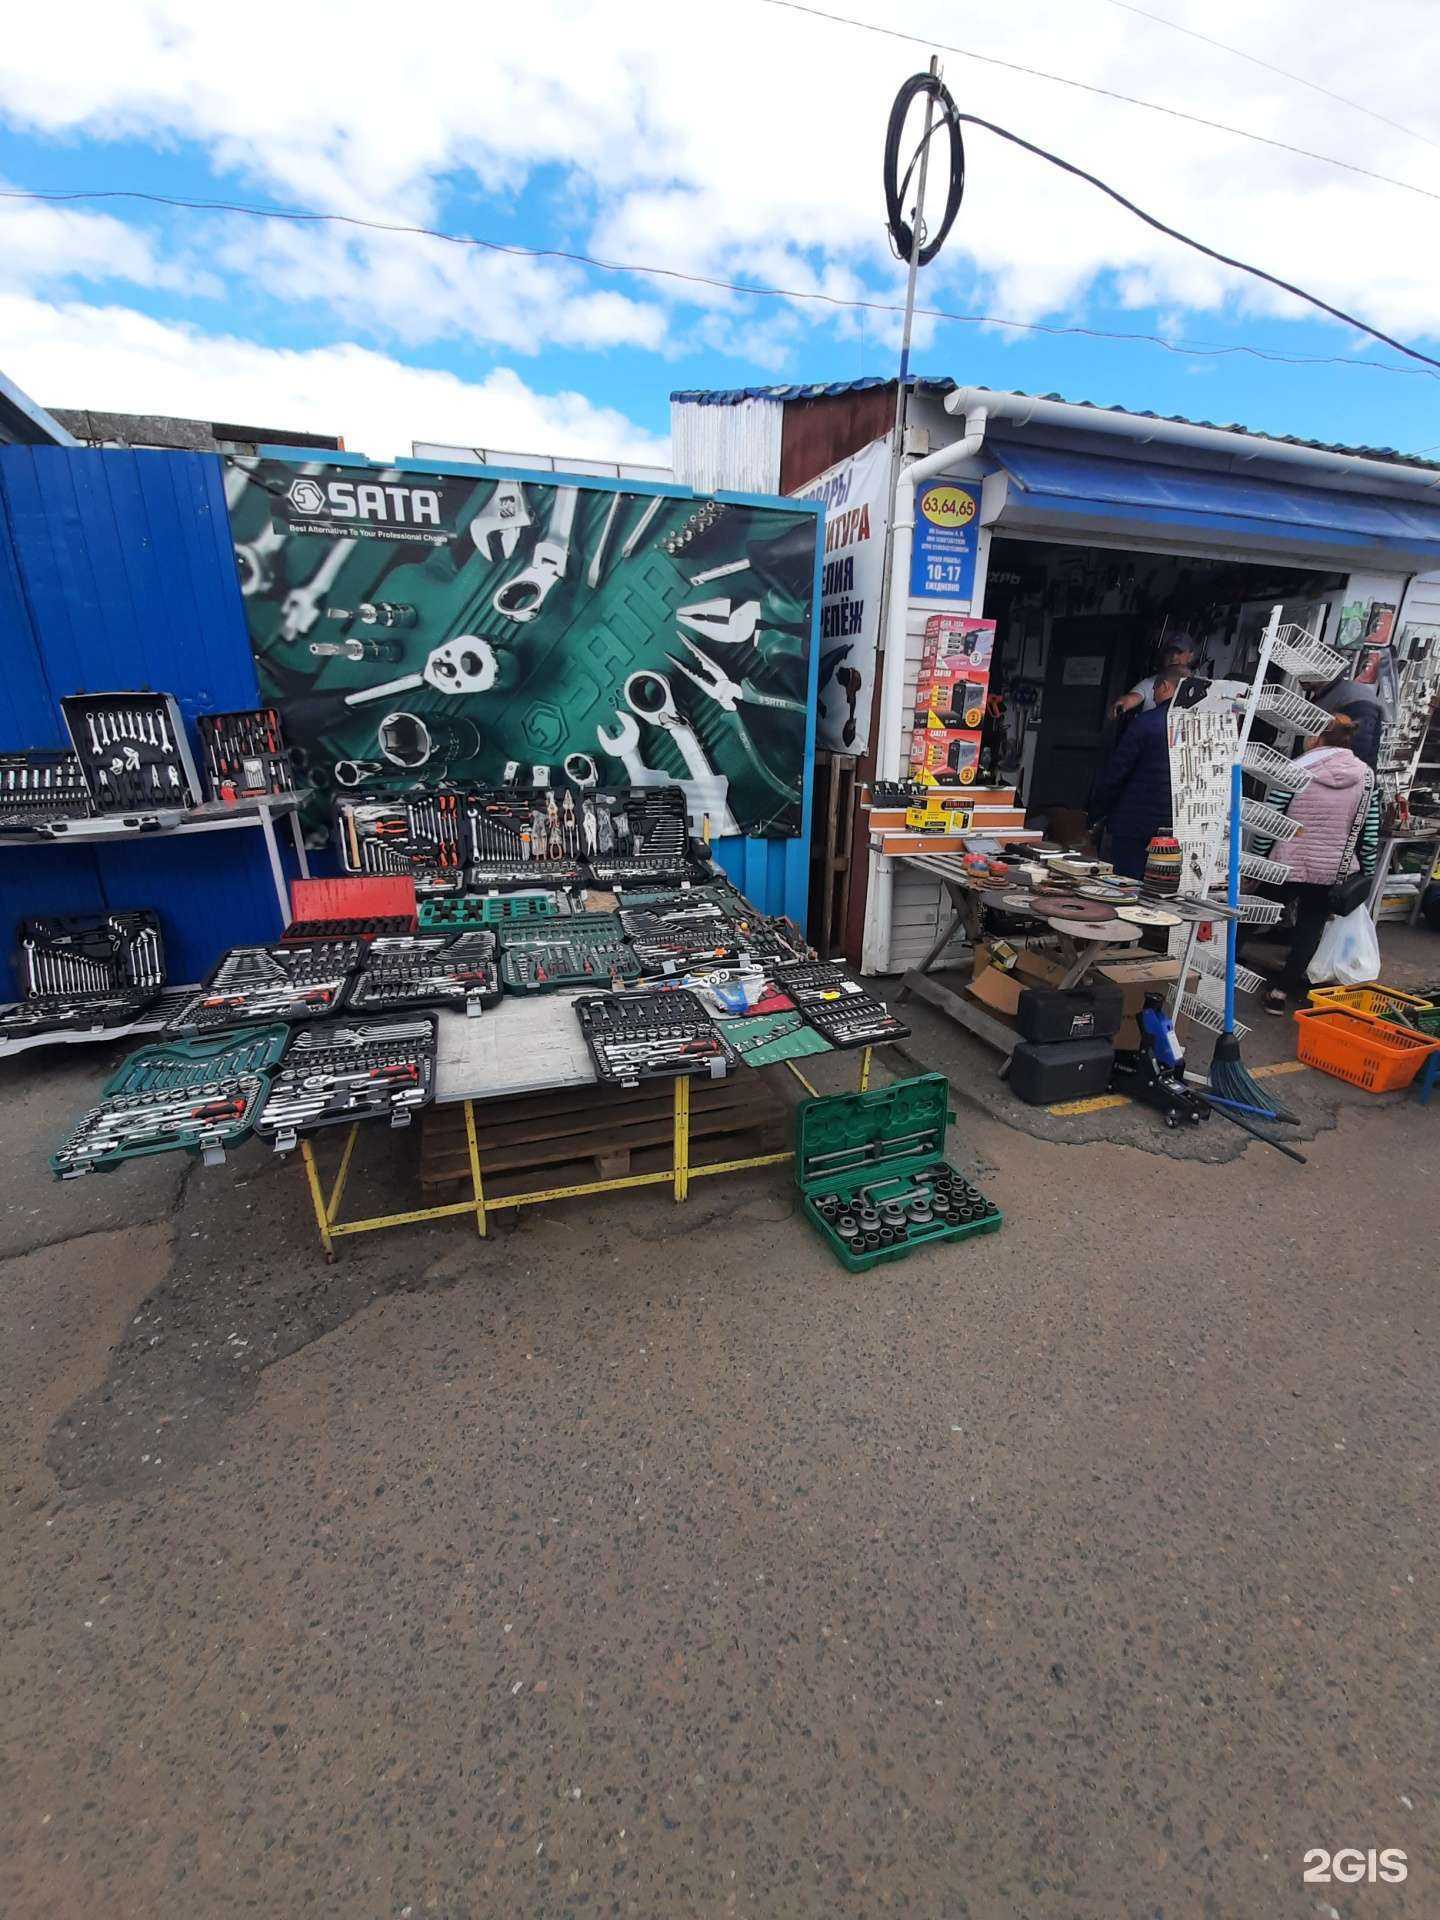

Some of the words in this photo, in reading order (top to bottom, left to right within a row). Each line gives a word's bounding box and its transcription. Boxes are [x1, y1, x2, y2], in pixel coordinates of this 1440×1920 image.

[327, 482, 441, 525] SATA
[923, 497, 974, 517] 63,64,65
[289, 524, 307, 533] Best
[308, 525, 348, 536] Alternative
[350, 528, 359, 537] To
[360, 529, 378, 538] Your
[378, 530, 422, 542] Professional
[825, 503, 870, 554] ИТУРА
[927, 564, 961, 581] 10-17
